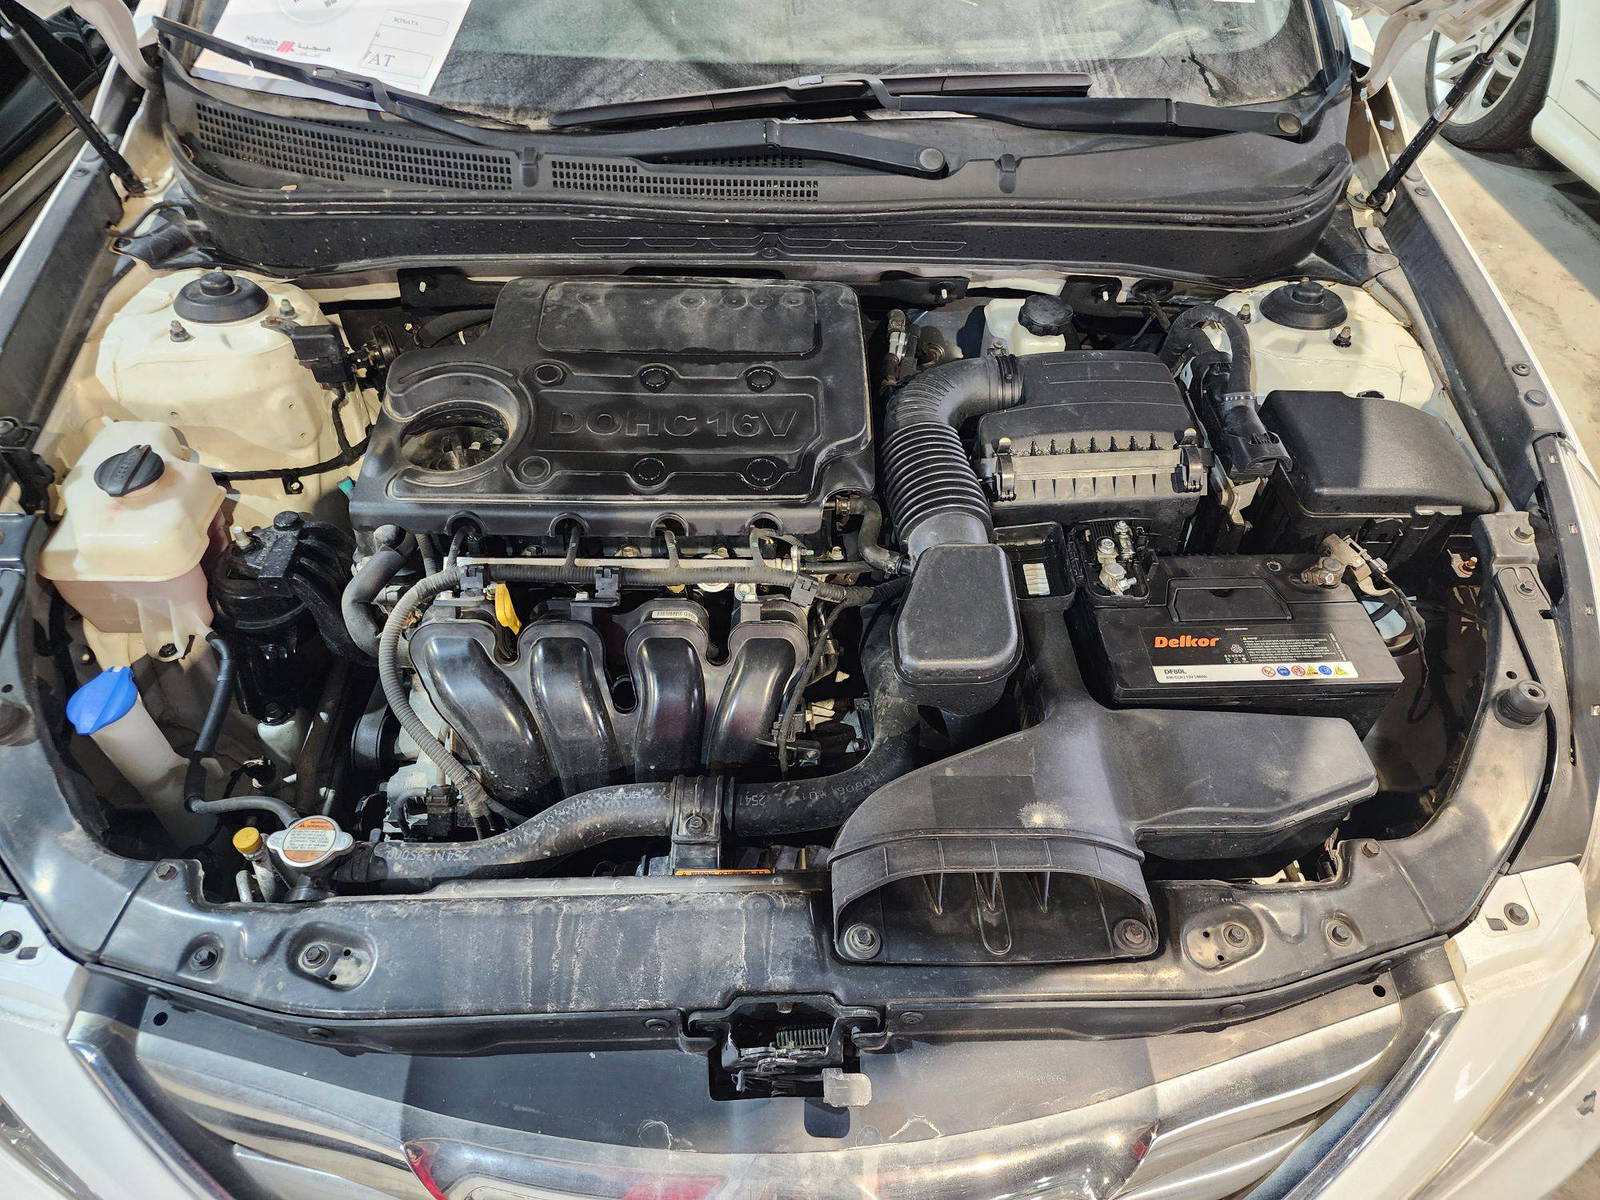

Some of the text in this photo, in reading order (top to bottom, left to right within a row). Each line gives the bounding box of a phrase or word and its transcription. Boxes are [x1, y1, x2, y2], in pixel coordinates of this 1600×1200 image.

[550, 411, 797, 437] DOHC 16V
[1154, 635, 1220, 648] Delkor
